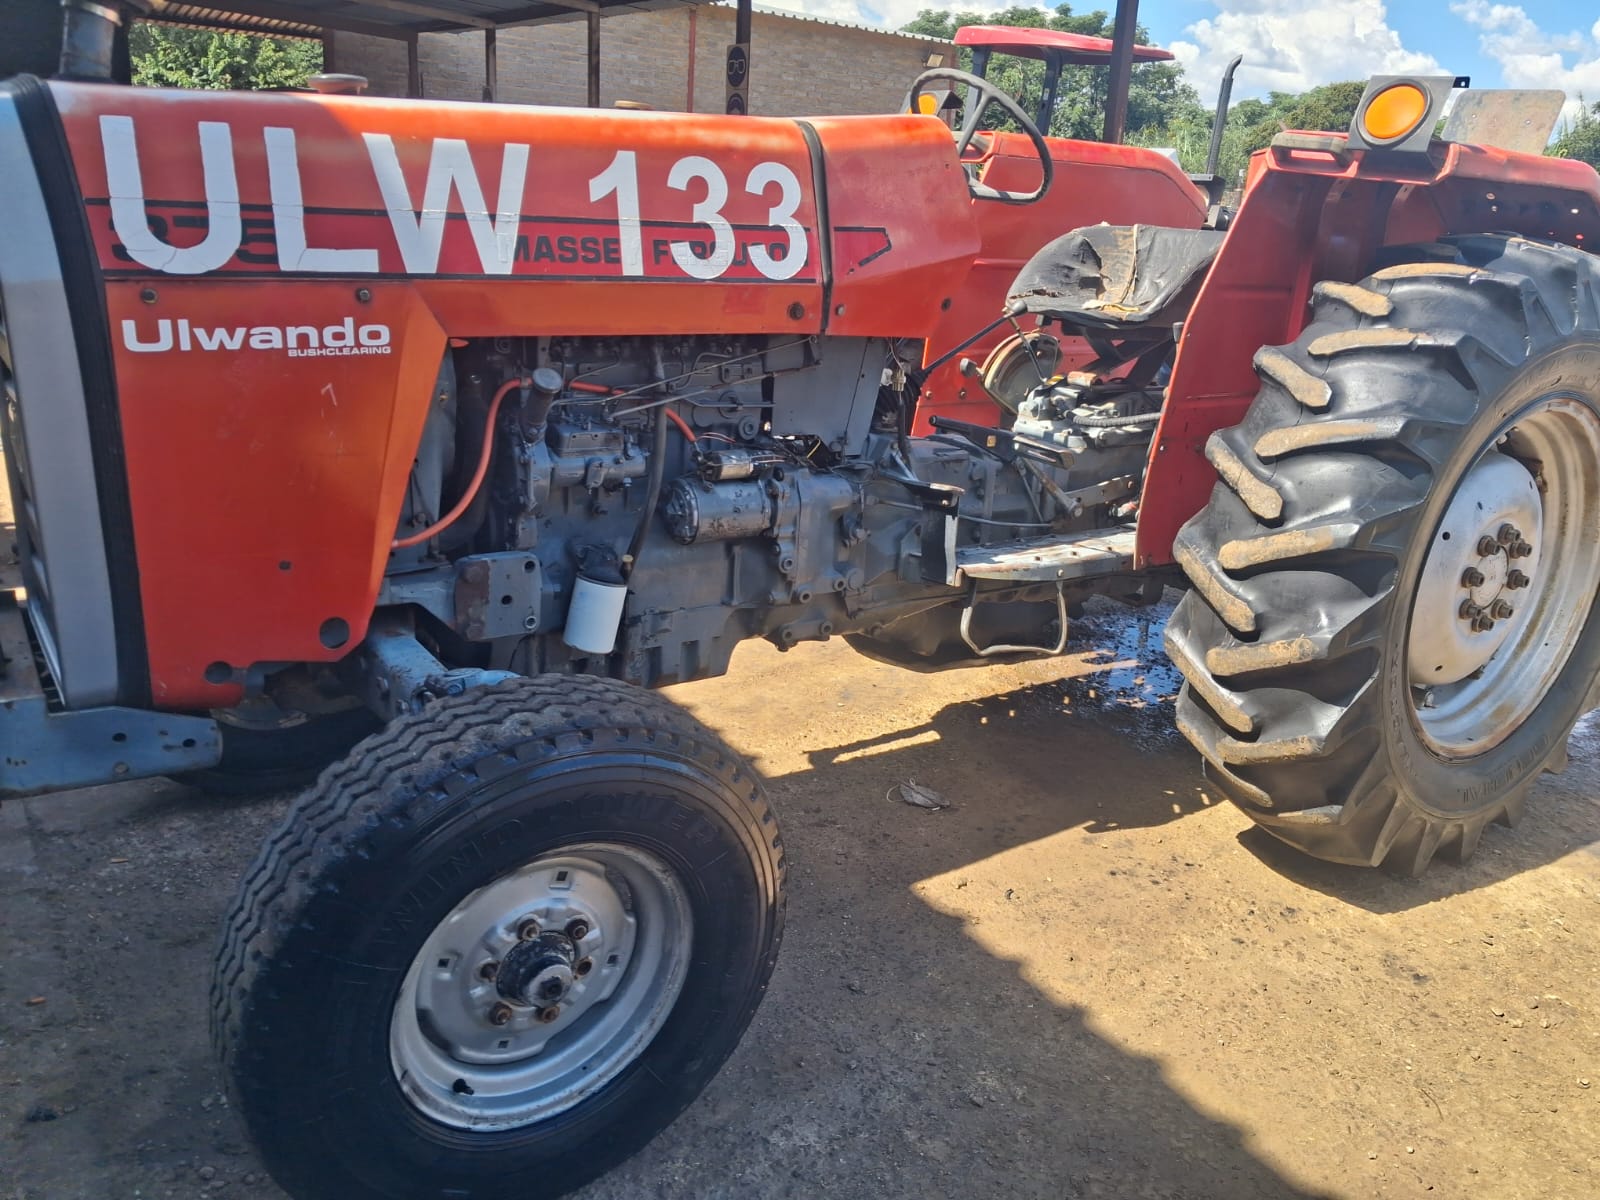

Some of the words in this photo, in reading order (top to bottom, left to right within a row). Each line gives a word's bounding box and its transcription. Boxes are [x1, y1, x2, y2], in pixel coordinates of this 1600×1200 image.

[99, 115, 530, 275] ULW
[589, 150, 808, 281] 133
[513, 235, 621, 264] MASSE
[121, 317, 391, 353] Ulwando
[288, 346, 392, 358] BUSHCLEARING
